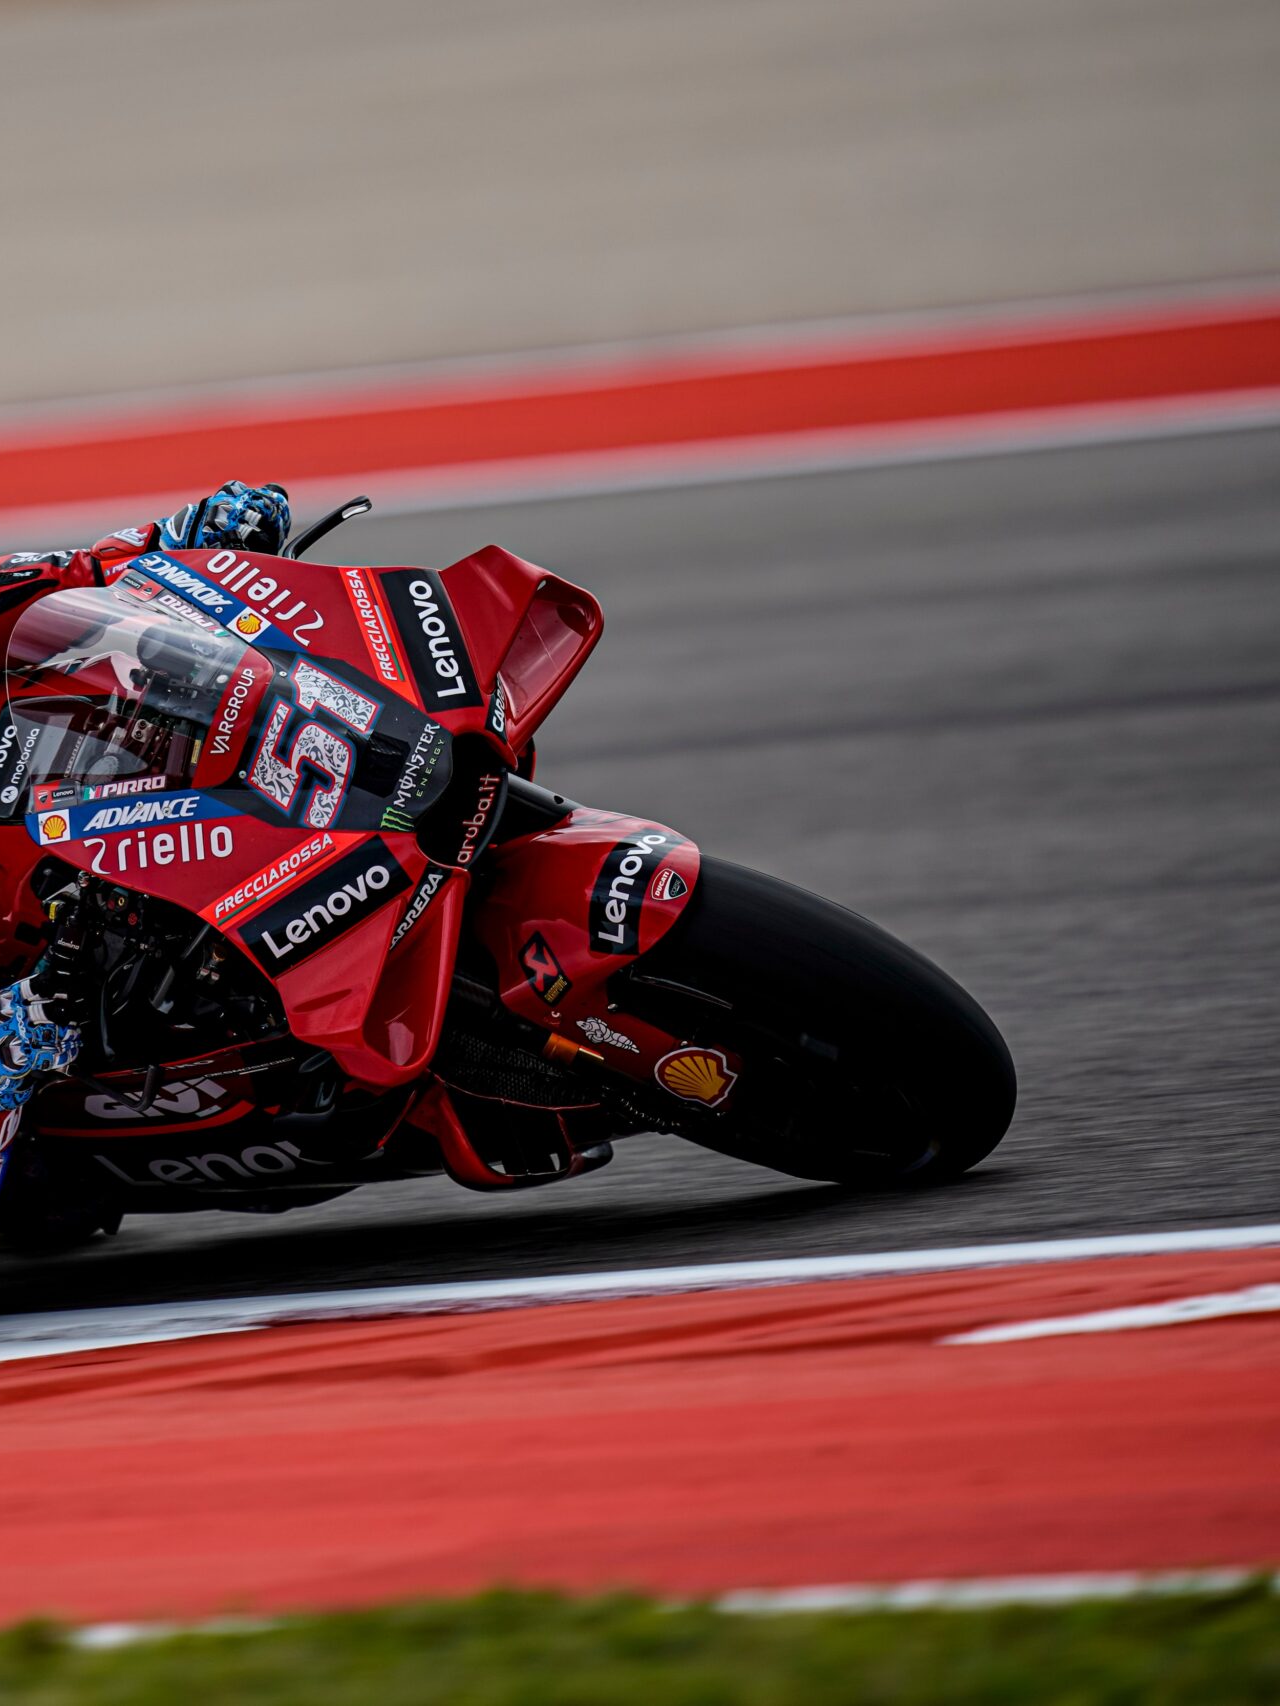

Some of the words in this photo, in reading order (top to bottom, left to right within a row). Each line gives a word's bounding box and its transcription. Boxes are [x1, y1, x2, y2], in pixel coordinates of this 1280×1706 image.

[138, 555, 233, 606] ADVANCE
[158, 594, 214, 628] PIRRO
[206, 550, 308, 622] riello
[346, 569, 398, 681] FRECCIAROSSA
[408, 580, 467, 698] Lenovo
[210, 668, 256, 755] VARGROUP
[247, 659, 380, 830] 51
[11, 727, 40, 786] motorola
[102, 775, 166, 798] PIRRO
[393, 722, 442, 808] MONSTER
[416, 738, 445, 798] ENERGY
[52, 789, 74, 798] Lenovo
[83, 796, 200, 832] ADVANCE
[457, 773, 501, 864] aruba.it
[118, 823, 233, 872] riello
[215, 833, 333, 919] FRECCIAROSSA
[261, 865, 390, 959] Lenovo
[387, 872, 445, 951] ARRERA
[598, 834, 667, 944] Lenovo
[654, 871, 670, 897] DUCATI
[92, 1140, 303, 1187] Leno
